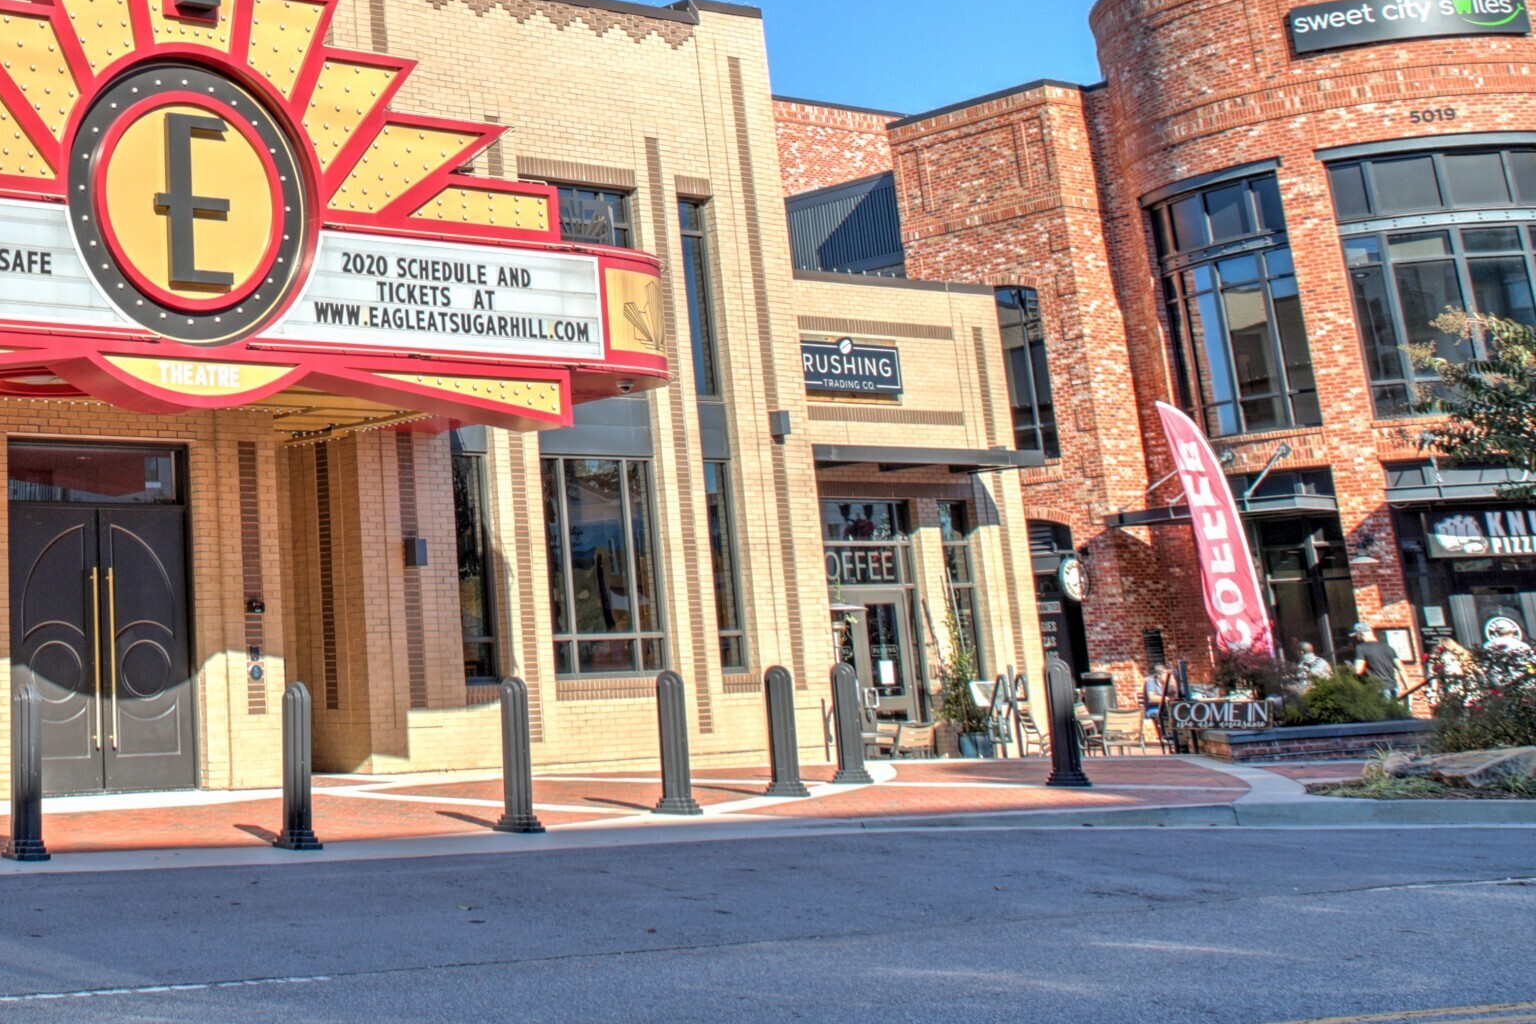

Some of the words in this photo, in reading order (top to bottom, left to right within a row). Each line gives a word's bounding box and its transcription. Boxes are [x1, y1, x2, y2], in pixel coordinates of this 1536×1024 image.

[1294, 3, 1376, 33] sweet
[1410, 107, 1457, 123] 5019
[153, 112, 234, 292] E
[342, 252, 388, 276] 2020
[396, 258, 488, 285] SCHEDULE
[497, 267, 531, 288] AND
[376, 281, 451, 307] TICKETS
[473, 290, 496, 311] AT
[314, 301, 590, 343] WWW.EAGLEATSUGARHILL.COM
[157, 361, 240, 388] THEATRE
[802, 353, 892, 377] RUSHING
[823, 378, 860, 389] TRADING
[862, 382, 875, 390] CO.
[1177, 438, 1252, 649] COFFEE
[1173, 702, 1242, 722] COME
[1247, 702, 1268, 722] IN
